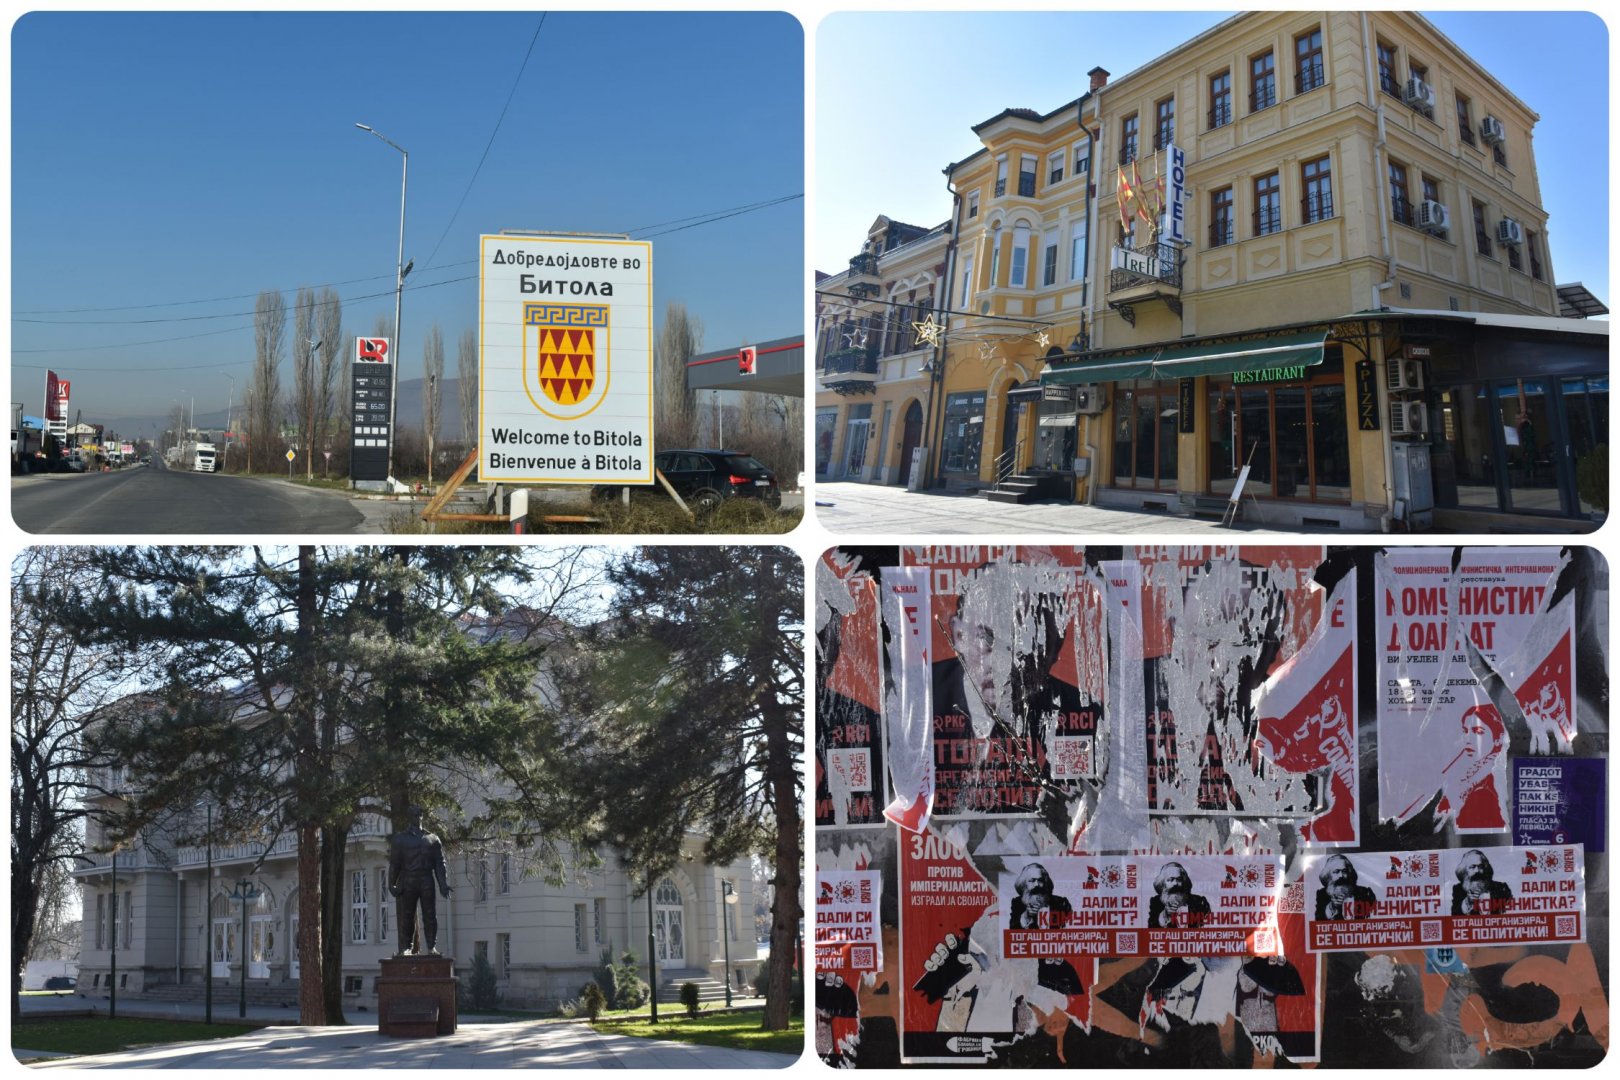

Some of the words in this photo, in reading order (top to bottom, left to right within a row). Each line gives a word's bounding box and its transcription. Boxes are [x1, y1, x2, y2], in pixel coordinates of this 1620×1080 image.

[1172, 147, 1184, 239] HOTEL
[493, 249, 617, 270] Добредојдовте
[623, 258, 641, 269] во
[520, 274, 613, 296] Битола
[1233, 365, 1306, 383] RESTAURANT
[1361, 370, 1374, 428] PIZZA
[492, 428, 569, 445] Welcome
[574, 430, 591, 445] to
[594, 430, 642, 446] Bitola
[490, 453, 576, 469] Bienvenue
[582, 455, 590, 470] à
[596, 454, 641, 470] Bitola
[1387, 655, 1439, 664] ВИУЕЛЕН
[1069, 712, 1094, 730] RCI
[845, 724, 870, 742] RCI
[1520, 768, 1561, 777] ГРАДОТ
[1555, 833, 1564, 844] 6
[928, 866, 964, 878] ПРОТИВ
[910, 881, 988, 892] ИМПЕРИЈАЛИСТИ
[1386, 886, 1421, 898] ДАЛИ
[1424, 885, 1440, 897] СИ
[1521, 881, 1556, 893] ДАЛИ
[1559, 880, 1576, 892] СИ
[911, 895, 946, 906] ИЗГРАДИ
[947, 896, 956, 906] ЈА
[957, 896, 989, 906] СВОЈАТА
[1082, 896, 1118, 909] ДАЛИ
[1121, 896, 1138, 908] СИ
[1220, 896, 1256, 908] ДАЛИ
[1259, 896, 1275, 907] СИ
[1473, 895, 1576, 912] КОМУНИСТКА?
[1343, 899, 1441, 917] КОМУНИСТ?
[816, 911, 852, 923] ДАЛИ
[856, 911, 872, 923] СИ
[1039, 910, 1138, 926] КОМУНИСТ?
[1452, 918, 1483, 928] ТОГАШ
[1485, 916, 1547, 926] ОРГАНИЗИРАЈ
[1316, 923, 1348, 933] ТОГАШ
[1349, 921, 1411, 932] ОРГАНИЗИРАЈ
[1452, 929, 1469, 941] СЕ
[1472, 926, 1548, 940] ПОЛИТИЧКИ!
[1010, 932, 1042, 941] ТОГАШ
[1044, 932, 1108, 941] ОРГАНИЗИРАЈ
[1148, 931, 1180, 940] ТОГАШ
[1182, 931, 1246, 940] ОРГАНИЗИРАЈ
[1316, 934, 1333, 946] СЕ
[1337, 931, 1414, 945] ПОЛИТИЧКИ!
[1010, 943, 1027, 955] СЕ
[1031, 942, 1110, 954] ПОЛИТИЧКИ!
[1149, 941, 1166, 954] СЕ
[1168, 941, 1247, 953] ПОЛИТИЧКИ!
